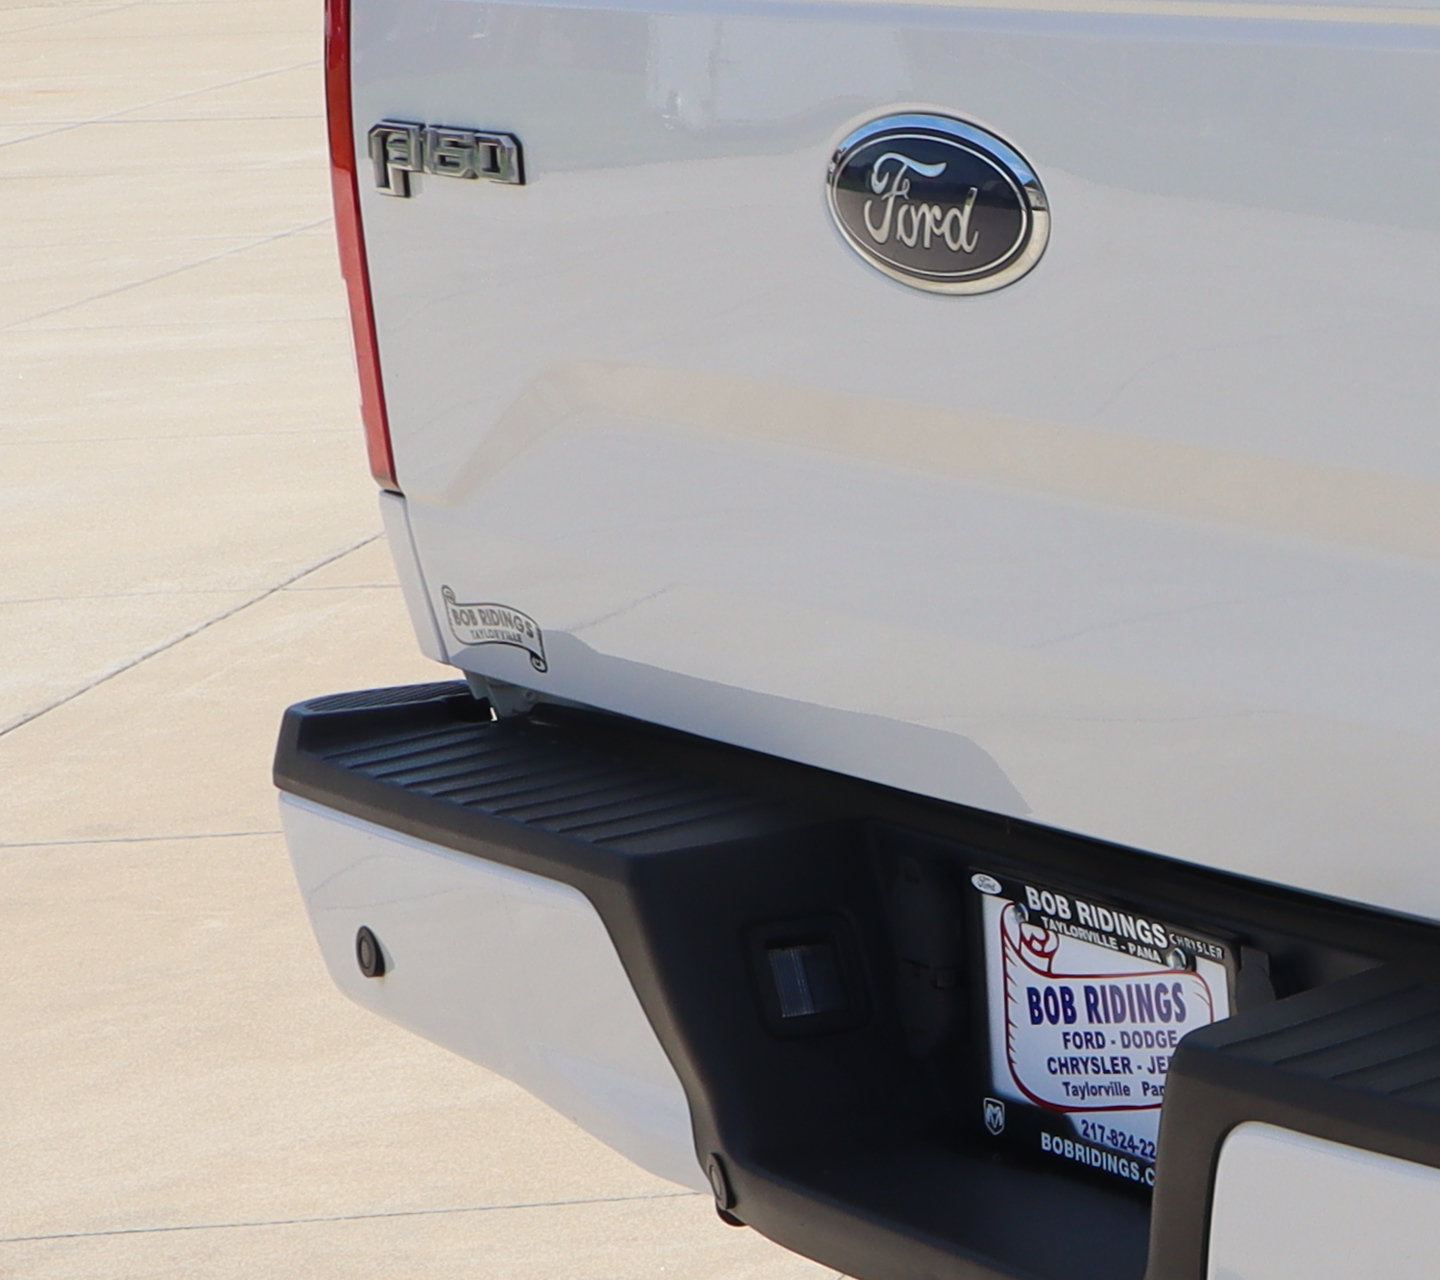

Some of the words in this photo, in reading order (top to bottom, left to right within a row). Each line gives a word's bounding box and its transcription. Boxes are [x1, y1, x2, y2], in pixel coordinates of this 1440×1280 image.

[864, 151, 980, 254] Ford
[451, 608, 478, 626] BOB
[478, 608, 534, 639] RIDINGS
[470, 629, 523, 644] TAYLORVILLE
[1025, 885, 1072, 920] BOB
[1075, 900, 1169, 949] RIDINGS
[1040, 916, 1119, 951] TAYLORVILLE
[1128, 941, 1162, 964] PANA
[1169, 932, 1225, 961] CHRYSLER
[1026, 985, 1077, 1026] BOB
[1084, 982, 1187, 1025] RIDINGS
[1062, 1031, 1106, 1050] FORD
[1120, 1030, 1178, 1049] DODGE
[1047, 1055, 1134, 1075] CHRYSLER
[1062, 1081, 1131, 1101] Taylorville
